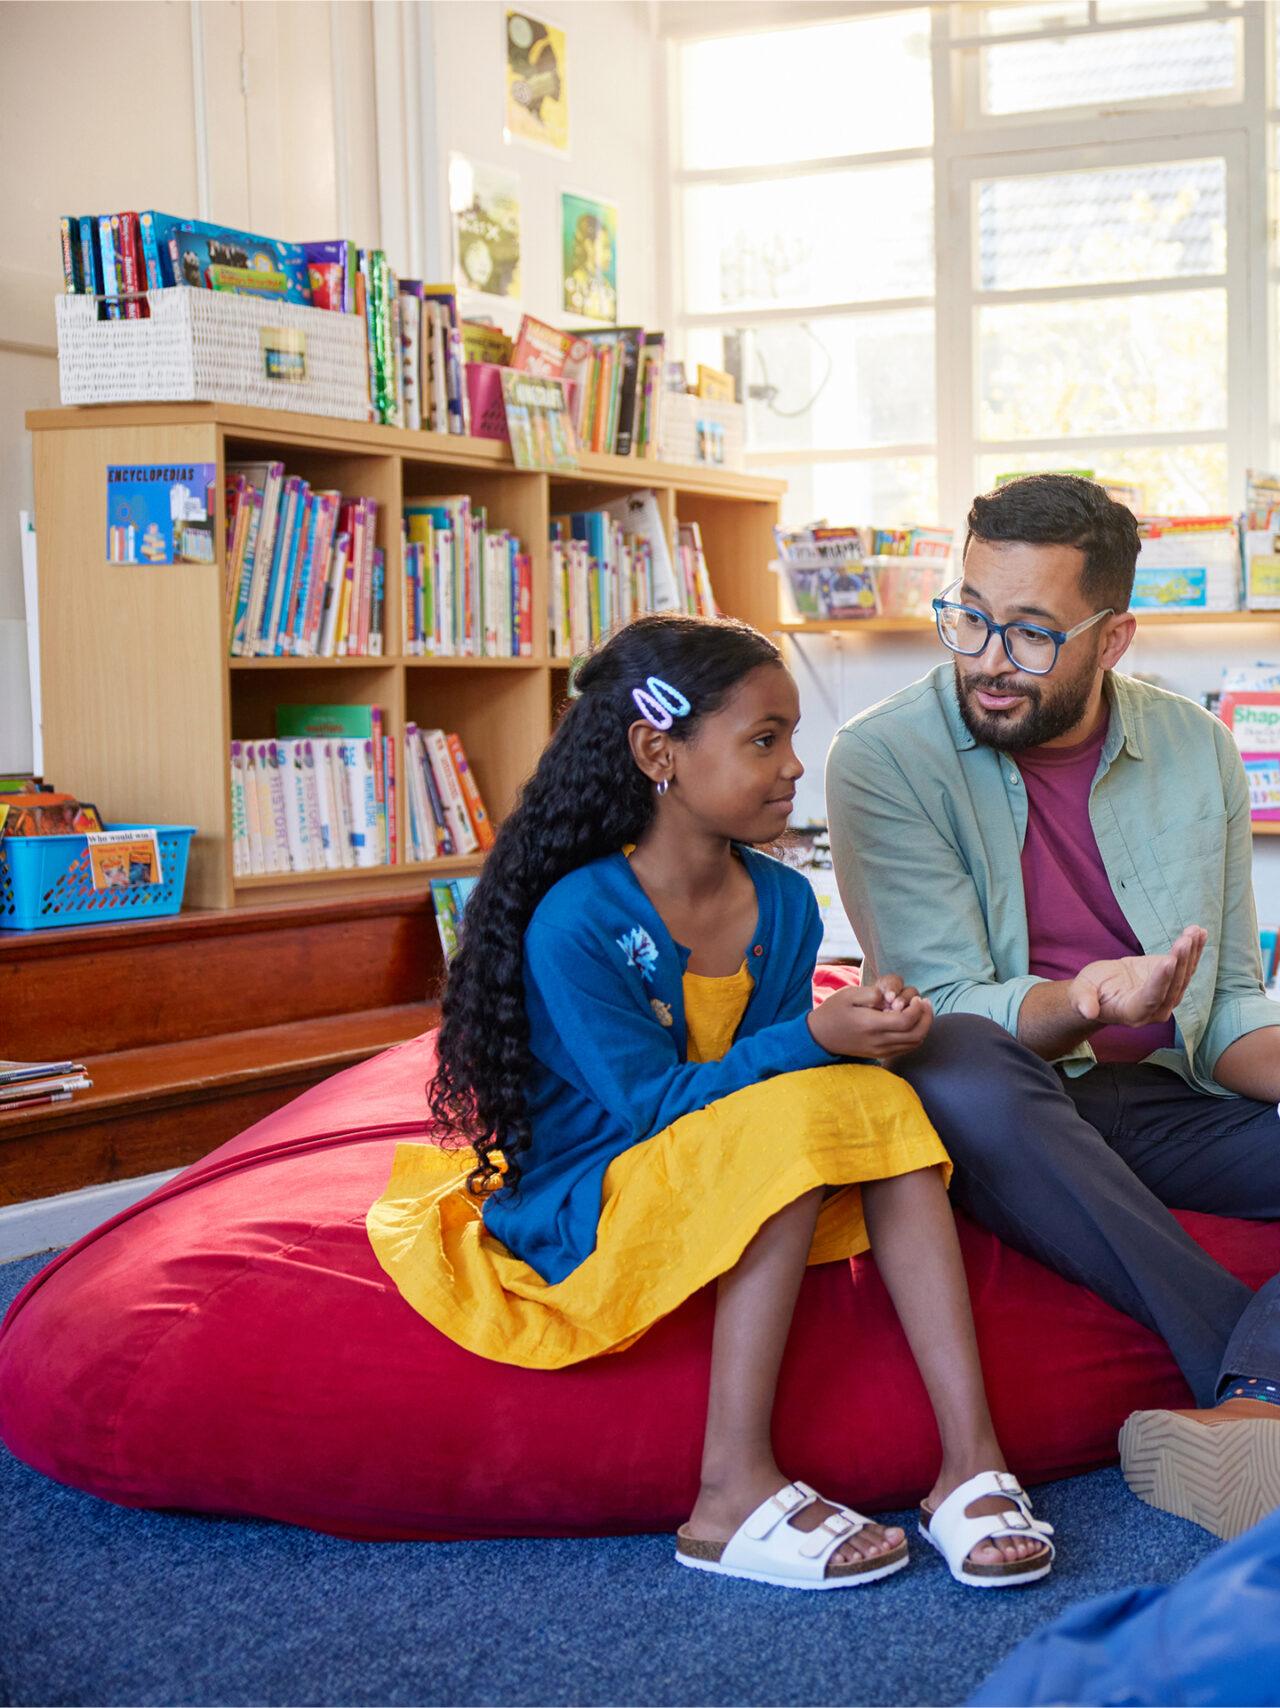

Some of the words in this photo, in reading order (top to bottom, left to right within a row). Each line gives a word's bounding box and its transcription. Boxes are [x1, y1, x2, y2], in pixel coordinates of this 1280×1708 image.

[108, 468, 194, 483] ENCYCLOPEDIAS
[270, 776, 290, 849] HISTORY
[296, 776, 309, 843] ANIMALS
[89, 834, 107, 843] Who
[110, 833, 133, 841] would
